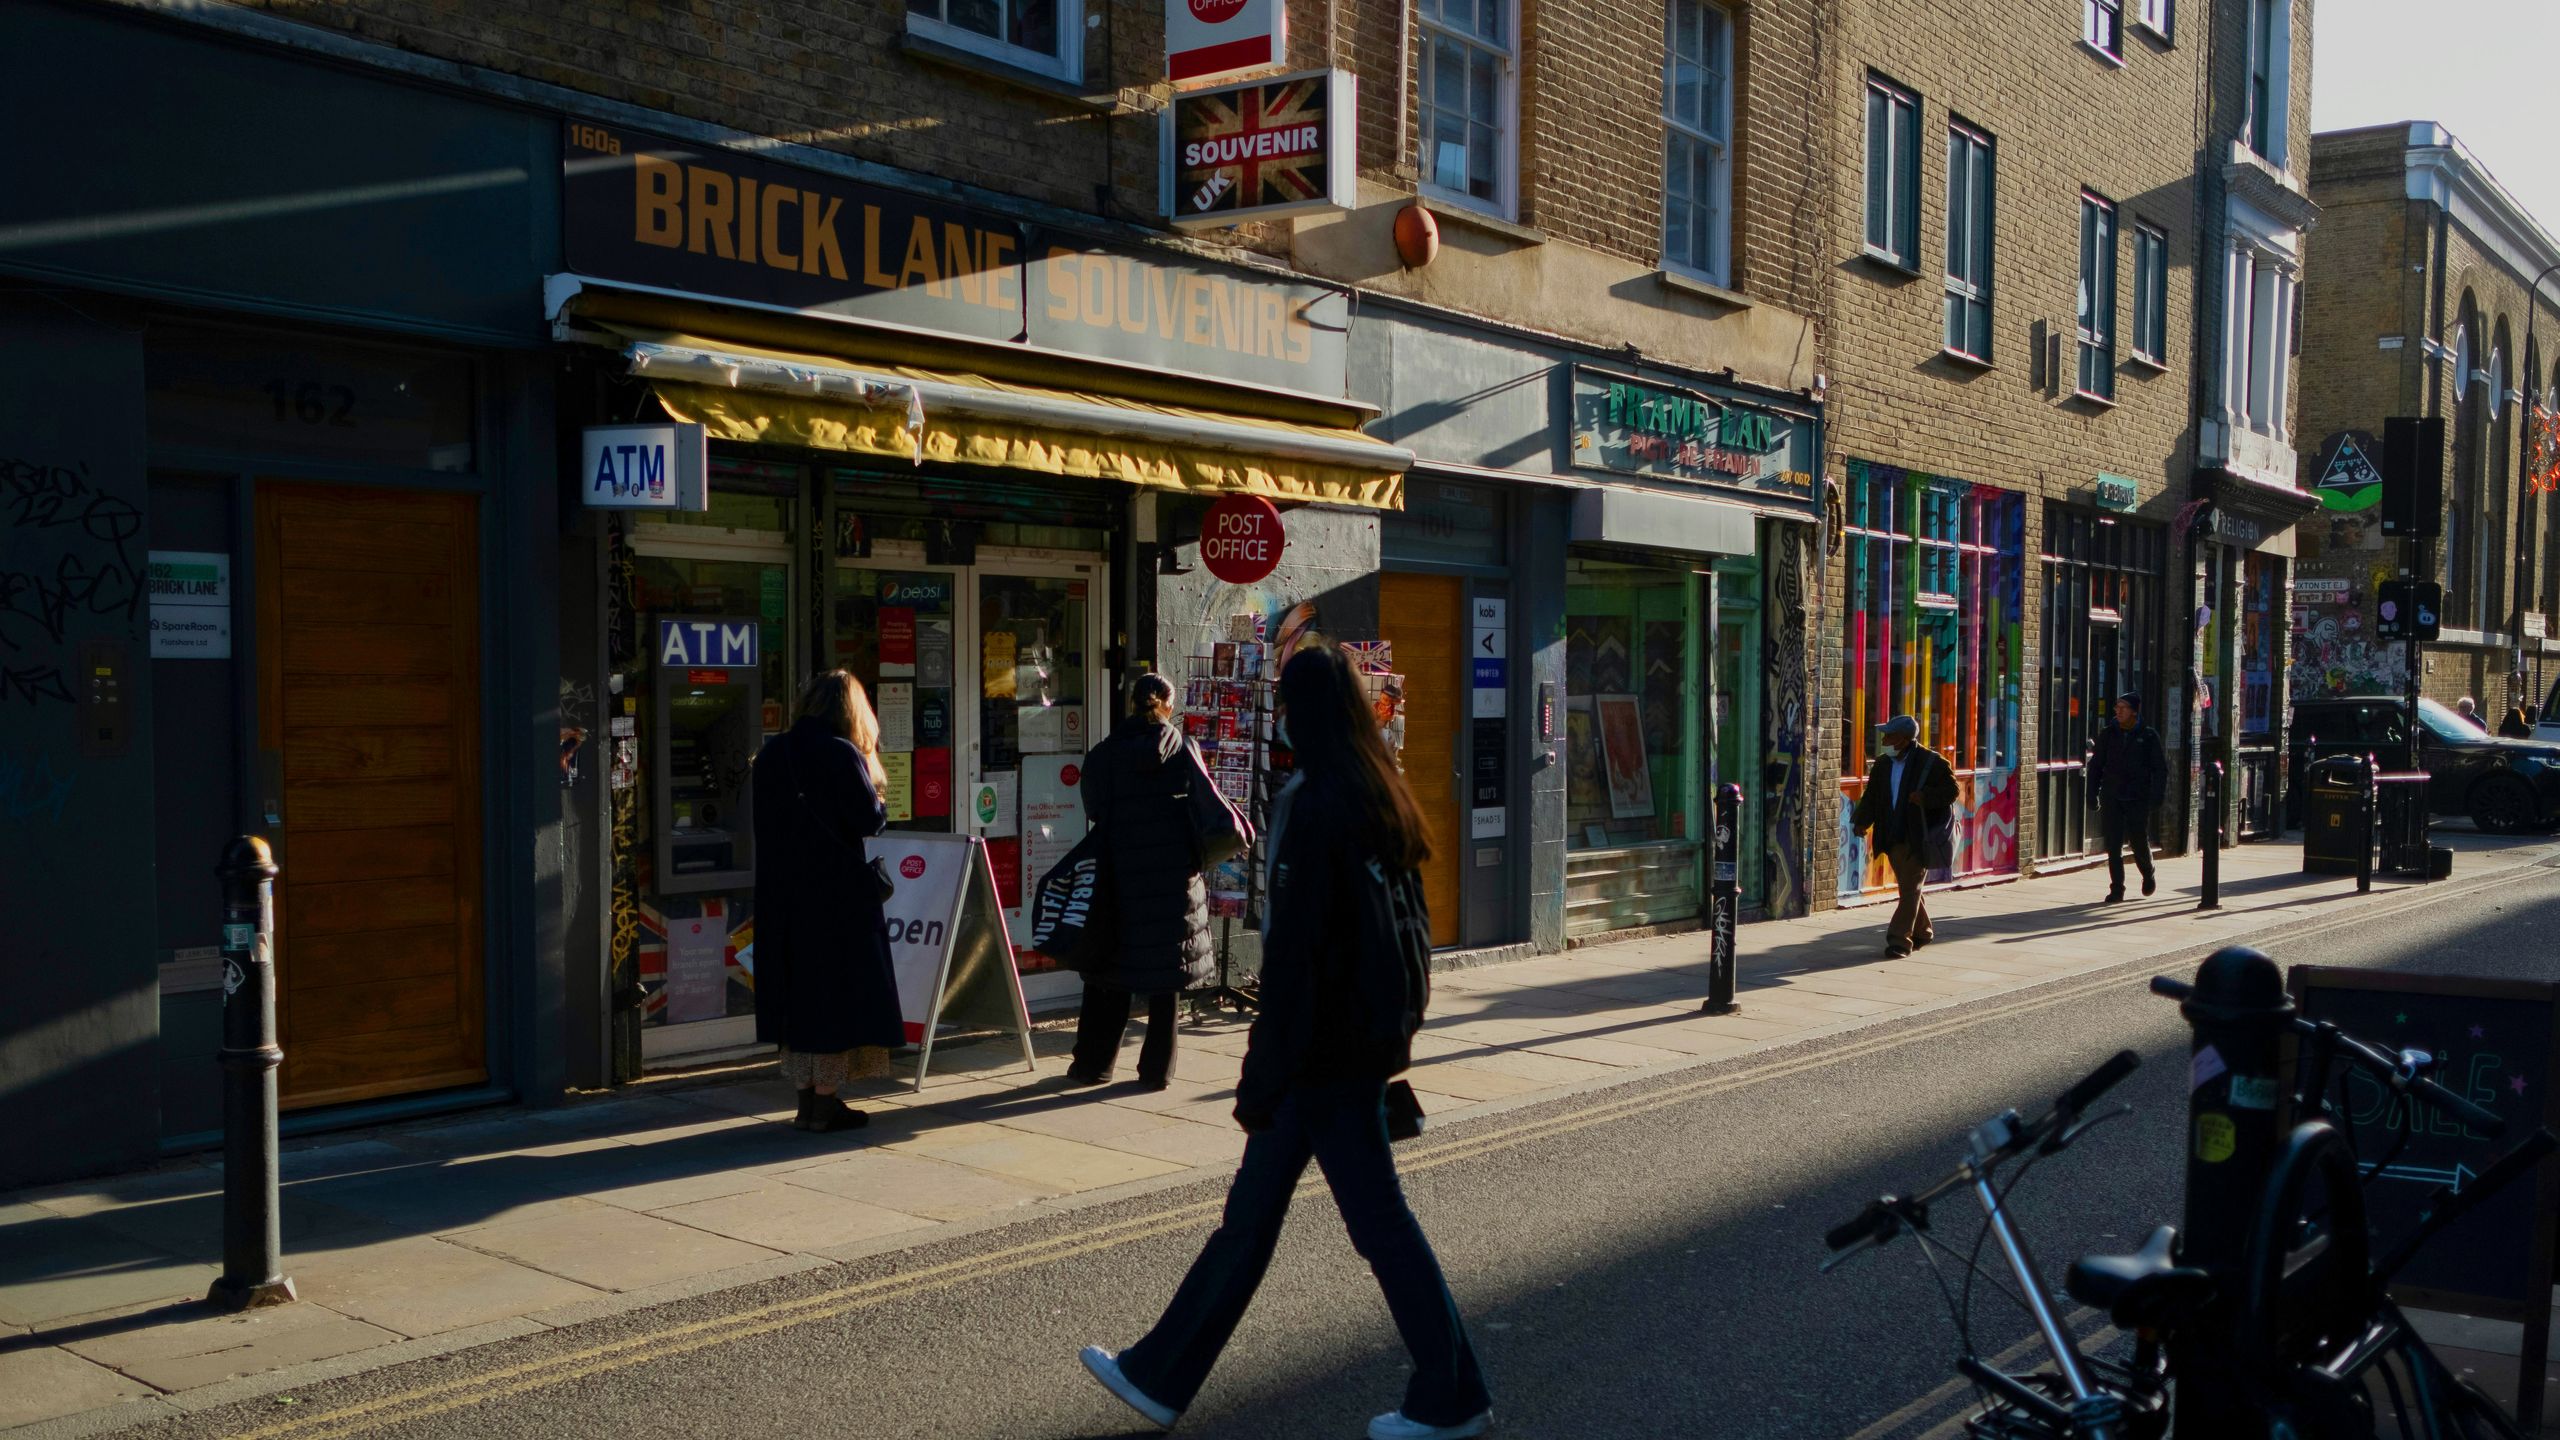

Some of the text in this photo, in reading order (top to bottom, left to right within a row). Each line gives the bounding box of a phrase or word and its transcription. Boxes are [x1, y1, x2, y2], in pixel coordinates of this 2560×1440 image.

[571, 122, 622, 157] 160a
[1185, 127, 1318, 167] SOUVENIR
[1192, 168, 1231, 212] UK
[634, 152, 1313, 364] BRICK LANE SOUVENIRS
[260, 378, 358, 429] 162
[594, 445, 665, 491] ATM
[1219, 513, 1264, 535] POST
[2221, 515, 2260, 541] RELIGION
[1206, 538, 1269, 561] OFFICE
[149, 563, 172, 578] 162
[149, 578, 218, 596] BRICK LANE
[901, 583, 941, 602] pepsi
[1479, 604, 1496, 619] kobi
[162, 621, 217, 632] SpareRoom
[160, 638, 208, 647] Flatshare Ltd
[662, 623, 750, 664] ATM
[923, 717, 943, 729] hub
[902, 866, 924, 874] OFFICE
[1061, 858, 1097, 928] URBAN
[886, 917, 944, 946] pen
